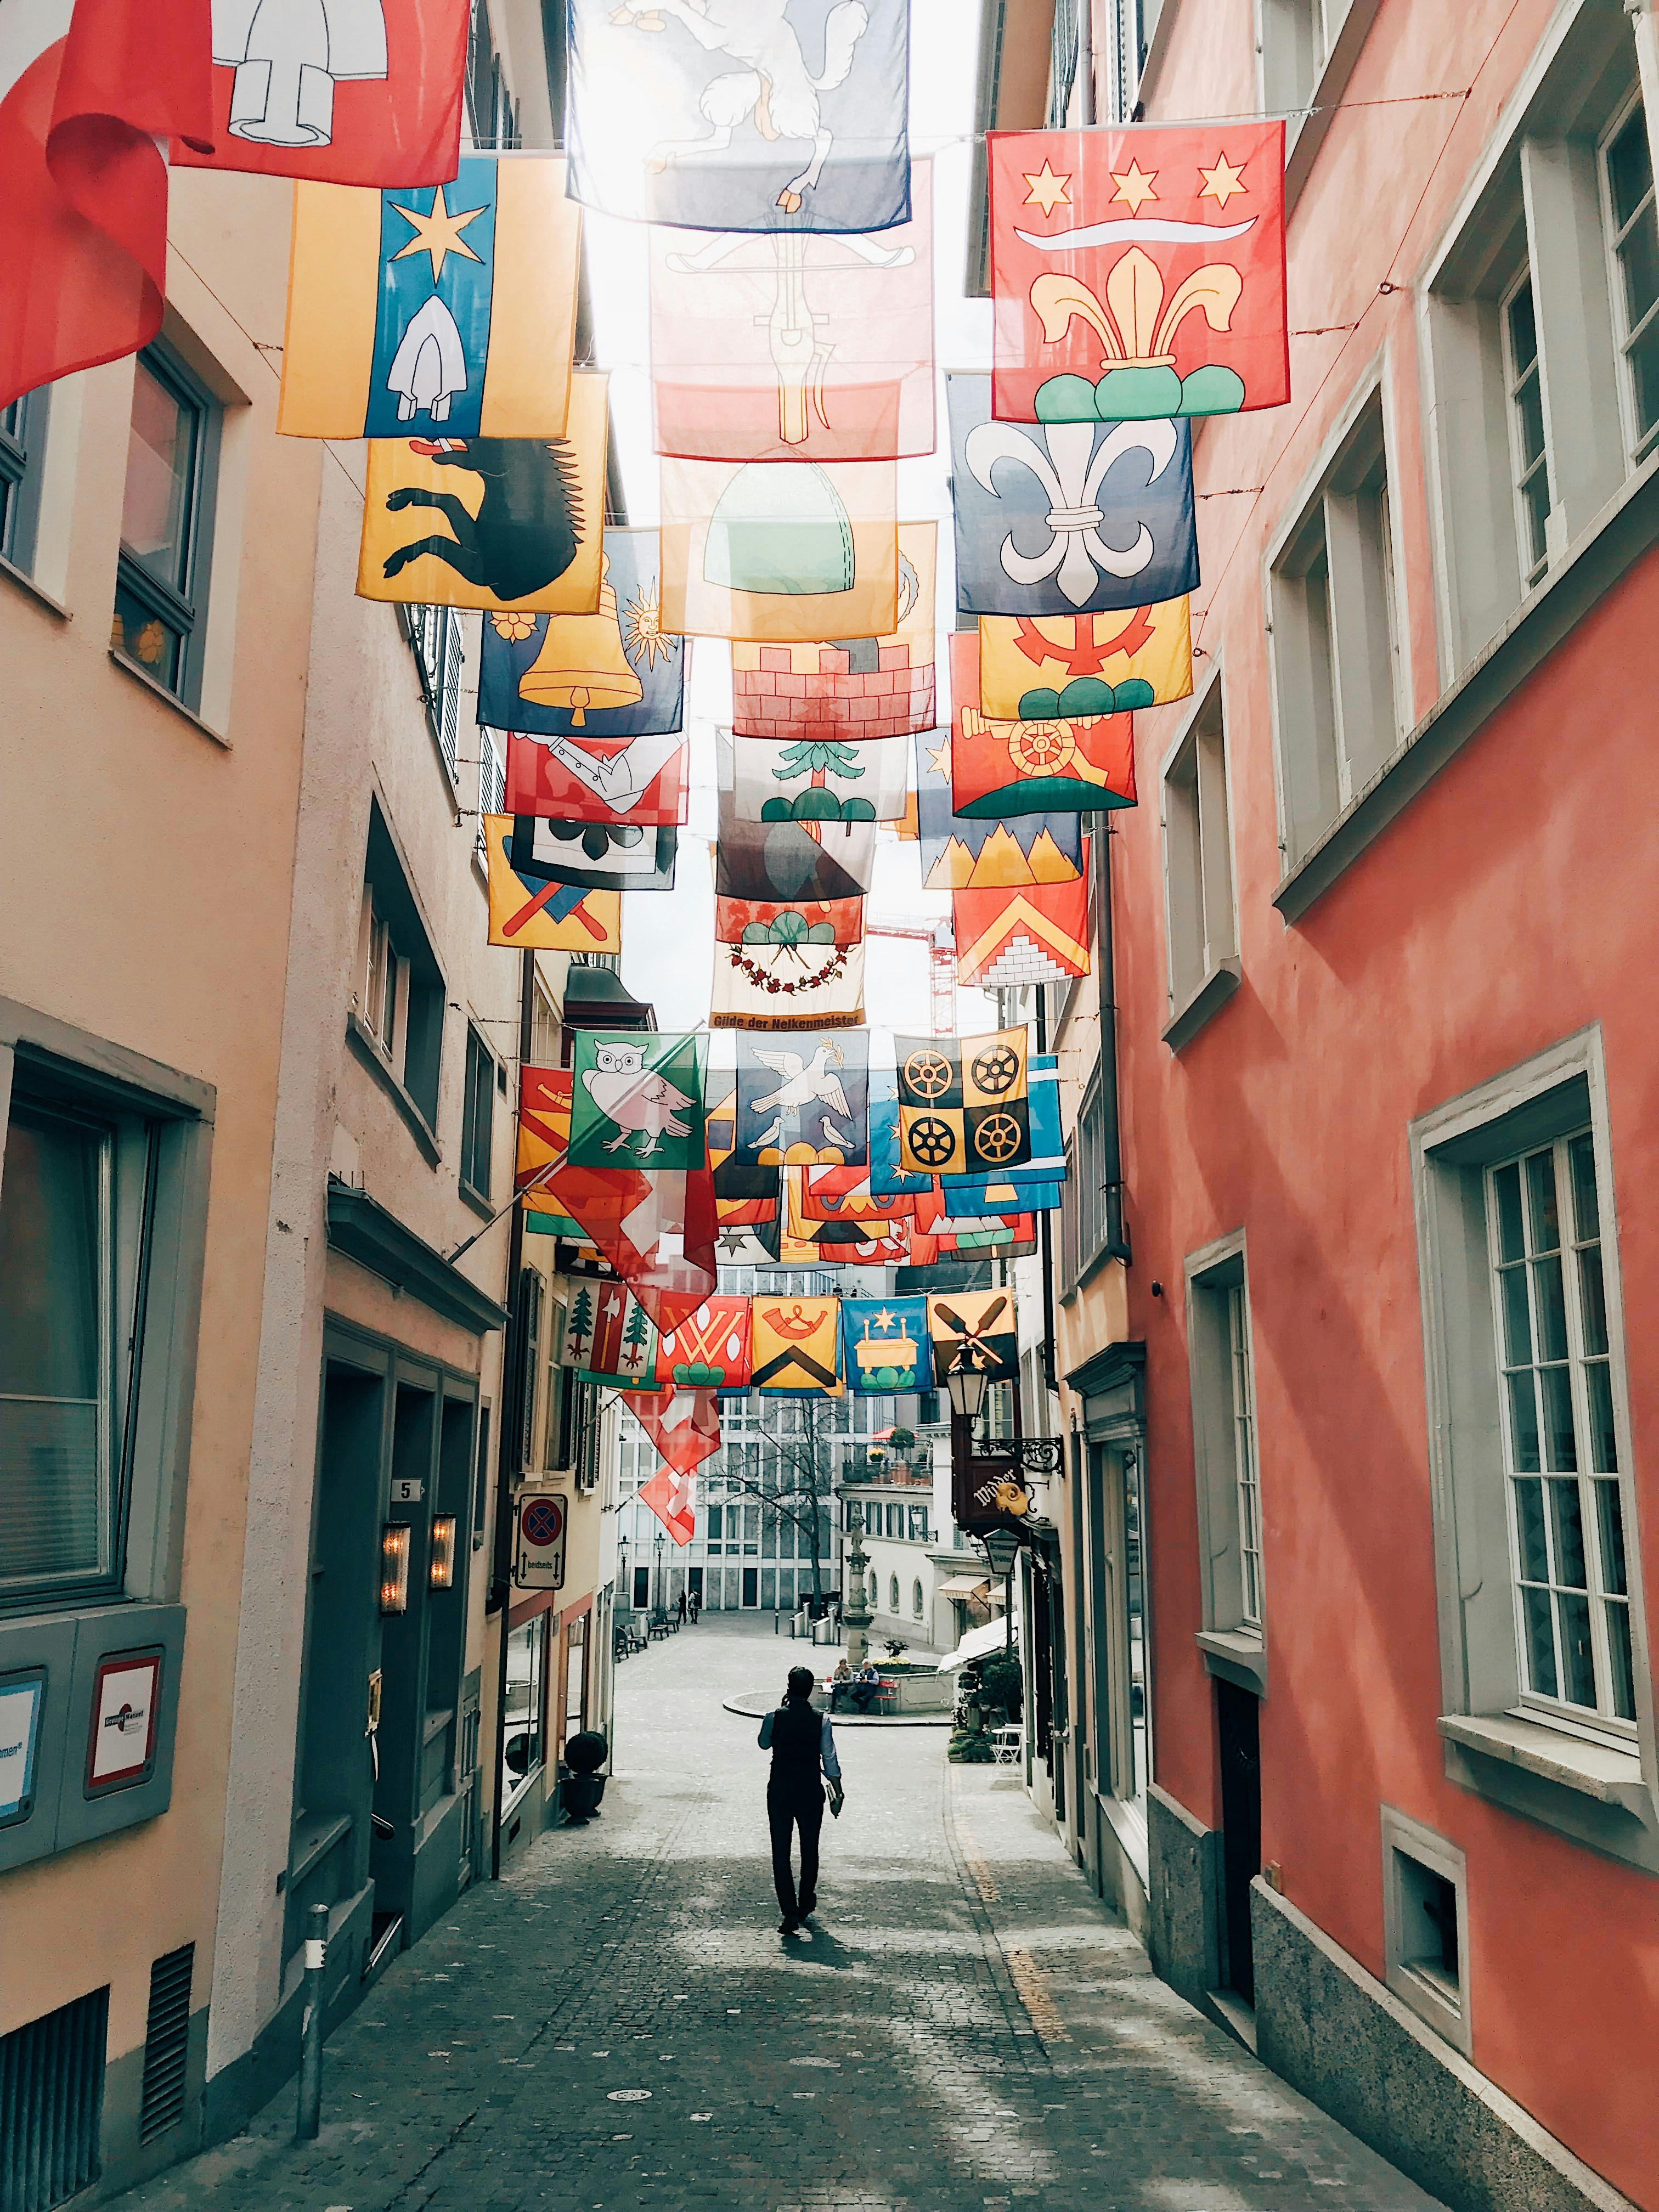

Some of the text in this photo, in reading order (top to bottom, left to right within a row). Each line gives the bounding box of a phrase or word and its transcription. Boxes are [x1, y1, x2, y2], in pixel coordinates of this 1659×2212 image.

[714, 1015, 859, 1029] Gilde der Nelkenmeister
[400, 1482, 411, 1499] 5
[528, 1560, 553, 1569] beidseits
